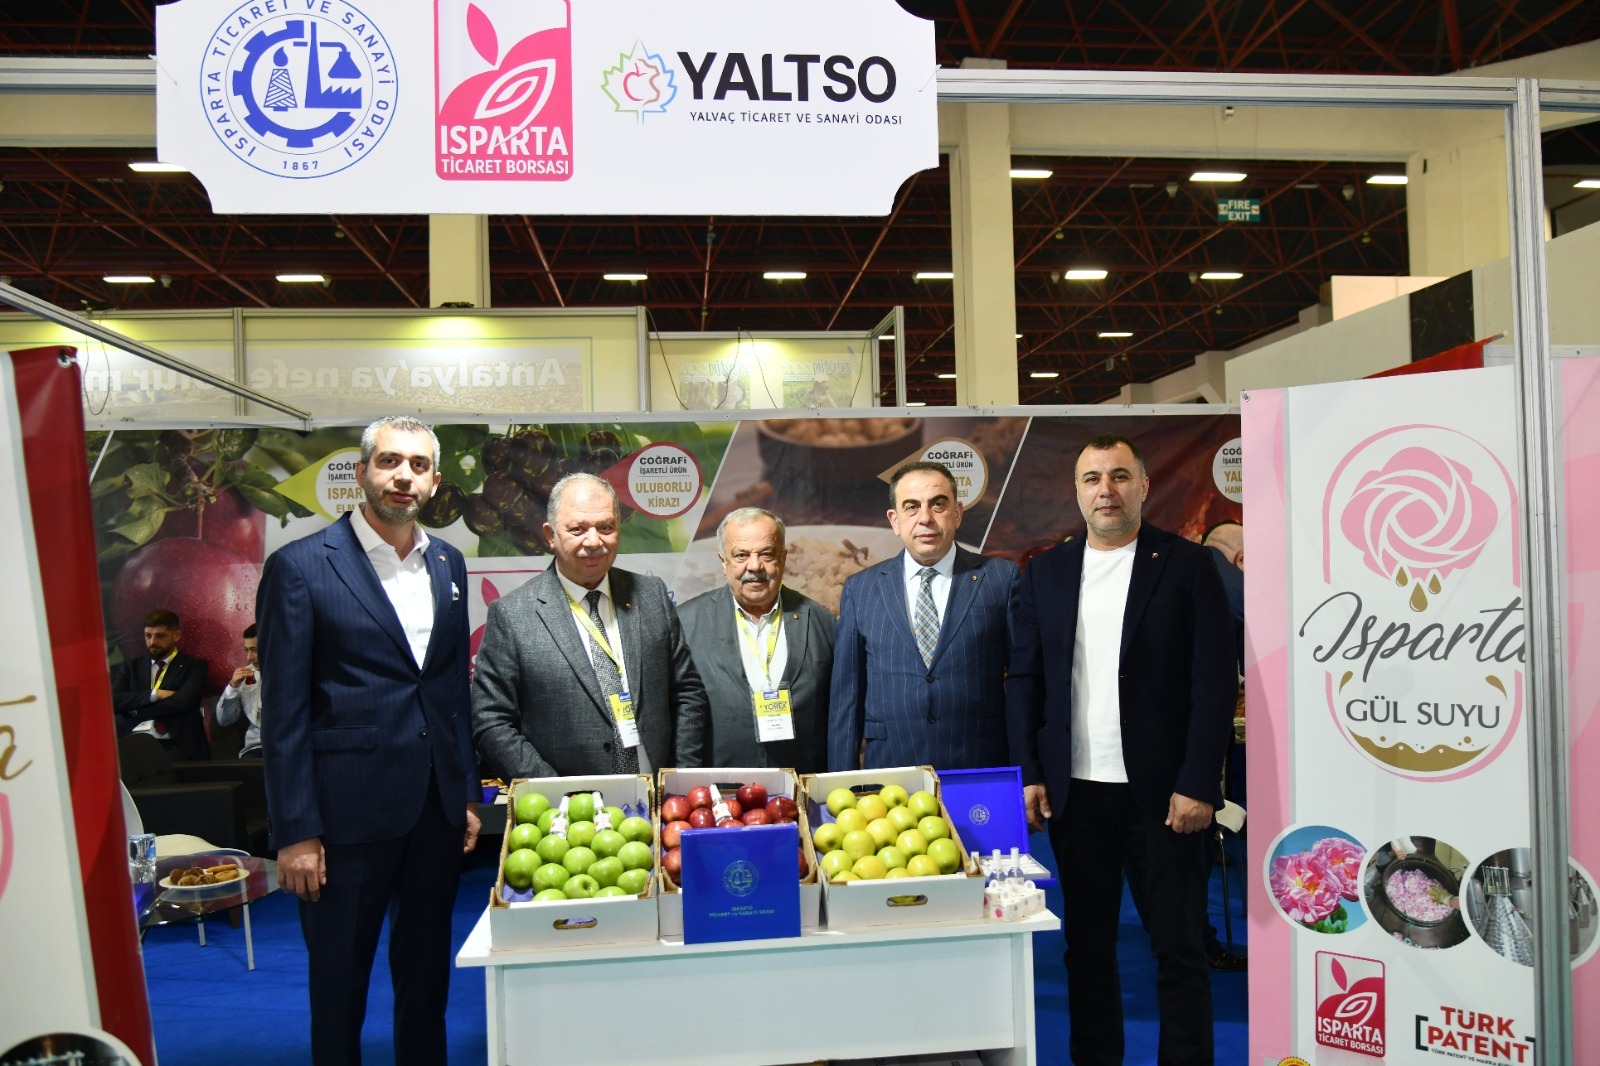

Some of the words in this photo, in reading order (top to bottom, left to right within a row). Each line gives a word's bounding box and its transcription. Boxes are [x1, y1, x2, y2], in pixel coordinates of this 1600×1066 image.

[306, 0, 332, 14] VE
[342, 12, 395, 84] SANAYİ
[677, 50, 898, 103] YALTSO
[207, 71, 257, 157] ISPARTA
[689, 111, 736, 125] YALVAÇ
[740, 110, 792, 124] TİCARET
[796, 112, 812, 124] VE
[816, 111, 860, 124] SANAYİ
[865, 115, 903, 125] ODASI
[344, 99, 390, 158] ODASI
[440, 124, 569, 156] ISPARTA
[282, 160, 319, 171] 1867
[441, 156, 503, 174] TİCARET
[506, 159, 569, 174] BORSASI
[1228, 199, 1251, 210] FIRE
[1228, 211, 1251, 221] EXIT
[328, 472, 357, 482] İŞARETL
[669, 466, 687, 474] ÜRÜN
[635, 482, 692, 493] ULUBORLU
[648, 496, 680, 508] KİRAZI
[1345, 694, 1407, 724] GÜL
[1417, 700, 1501, 729] SUYU
[1317, 1016, 1384, 1045] ISPARTA
[1440, 1005, 1516, 1039] TÜRK
[1318, 1032, 1349, 1047] TİCARET
[1350, 1040, 1384, 1055] BORSASI
[1427, 1025, 1530, 1064] PATENT
